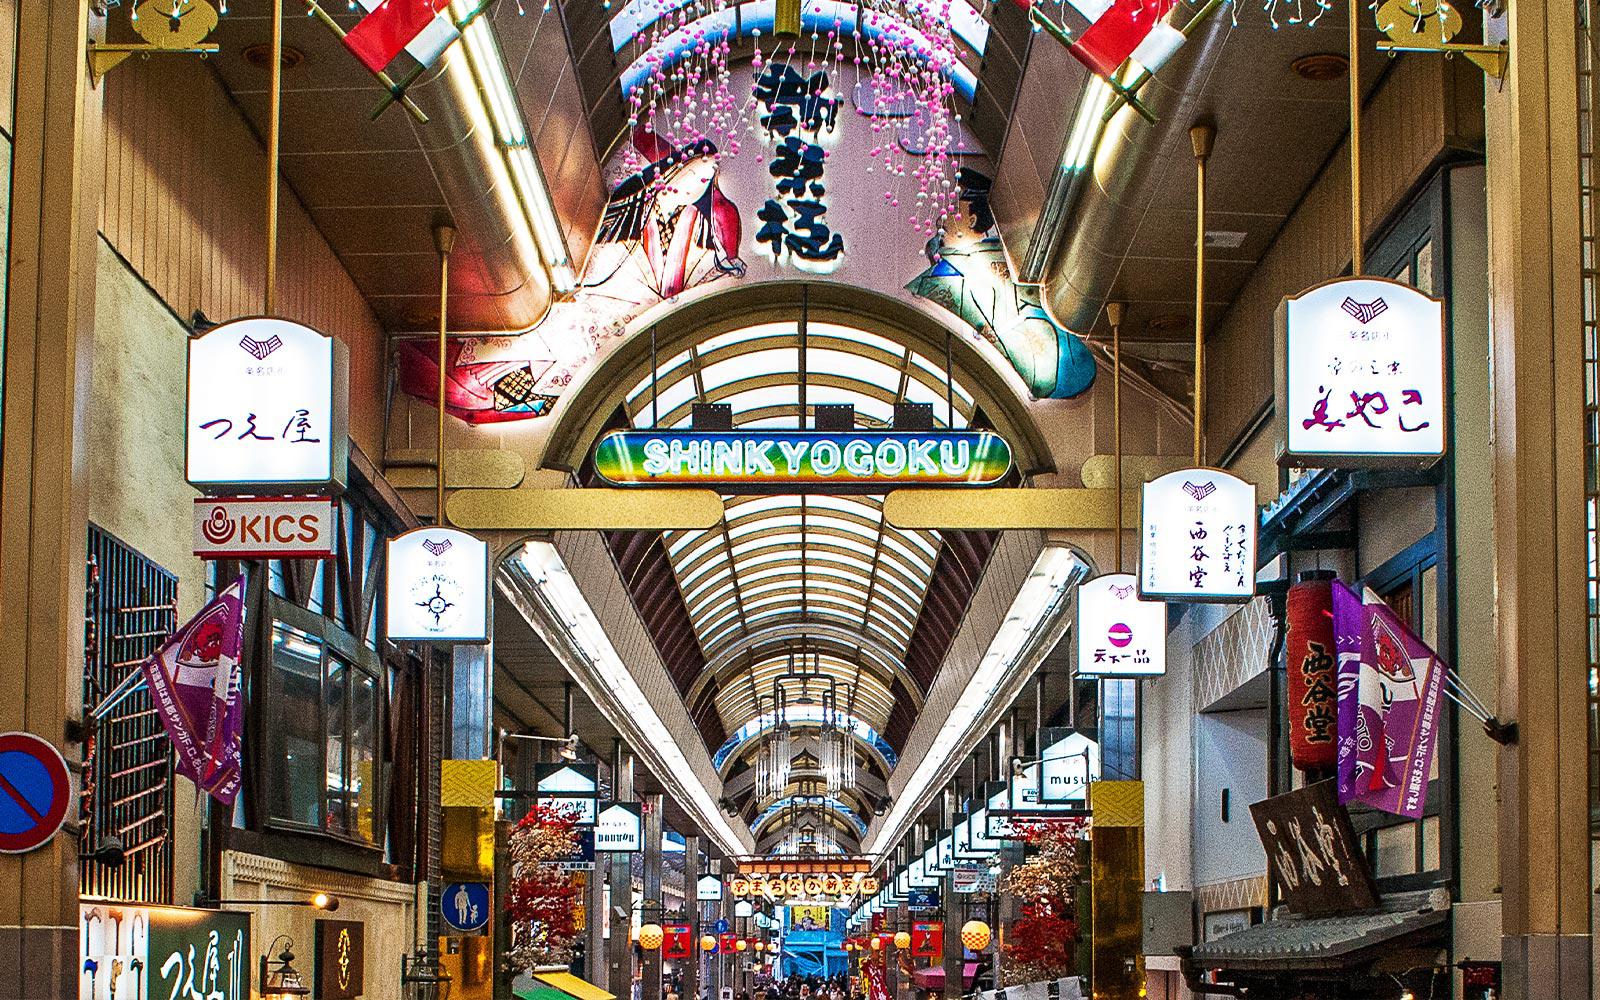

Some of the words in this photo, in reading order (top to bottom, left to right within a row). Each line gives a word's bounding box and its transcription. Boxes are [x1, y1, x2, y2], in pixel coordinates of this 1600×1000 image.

[752, 63, 844, 261] 新京極
[199, 409, 320, 443] つえ屋
[643, 438, 970, 477] SHINKYOGOKU
[240, 514, 319, 543] KICS
[1189, 521, 1210, 588] 西谷堂
[1300, 640, 1337, 744] 西谷堂
